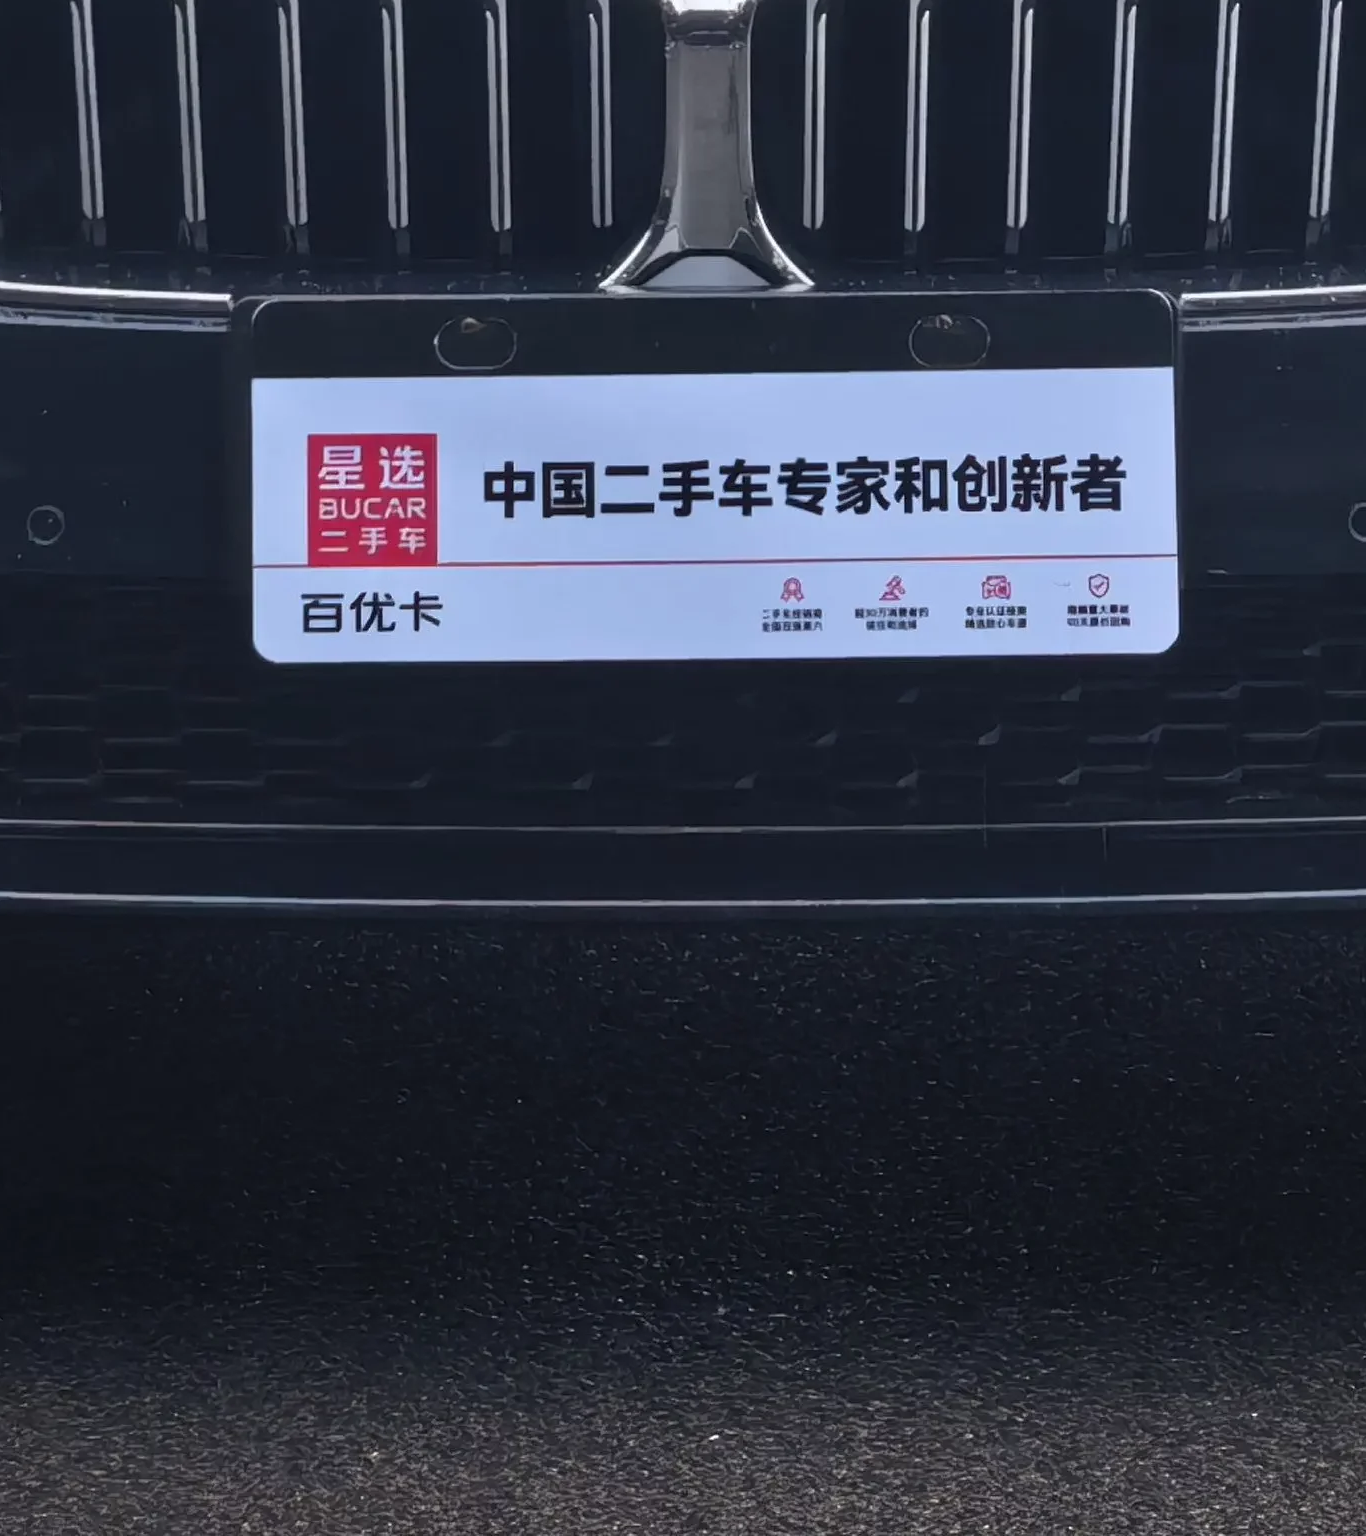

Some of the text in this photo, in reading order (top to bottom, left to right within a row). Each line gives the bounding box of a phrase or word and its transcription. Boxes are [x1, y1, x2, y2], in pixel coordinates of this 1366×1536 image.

[318, 445, 425, 490] 星选
[483, 453, 1128, 519] 中国二手车专家和创新者
[318, 497, 427, 520] BUCAR
[318, 527, 426, 555] 二手车
[301, 591, 443, 633] 百优卡
